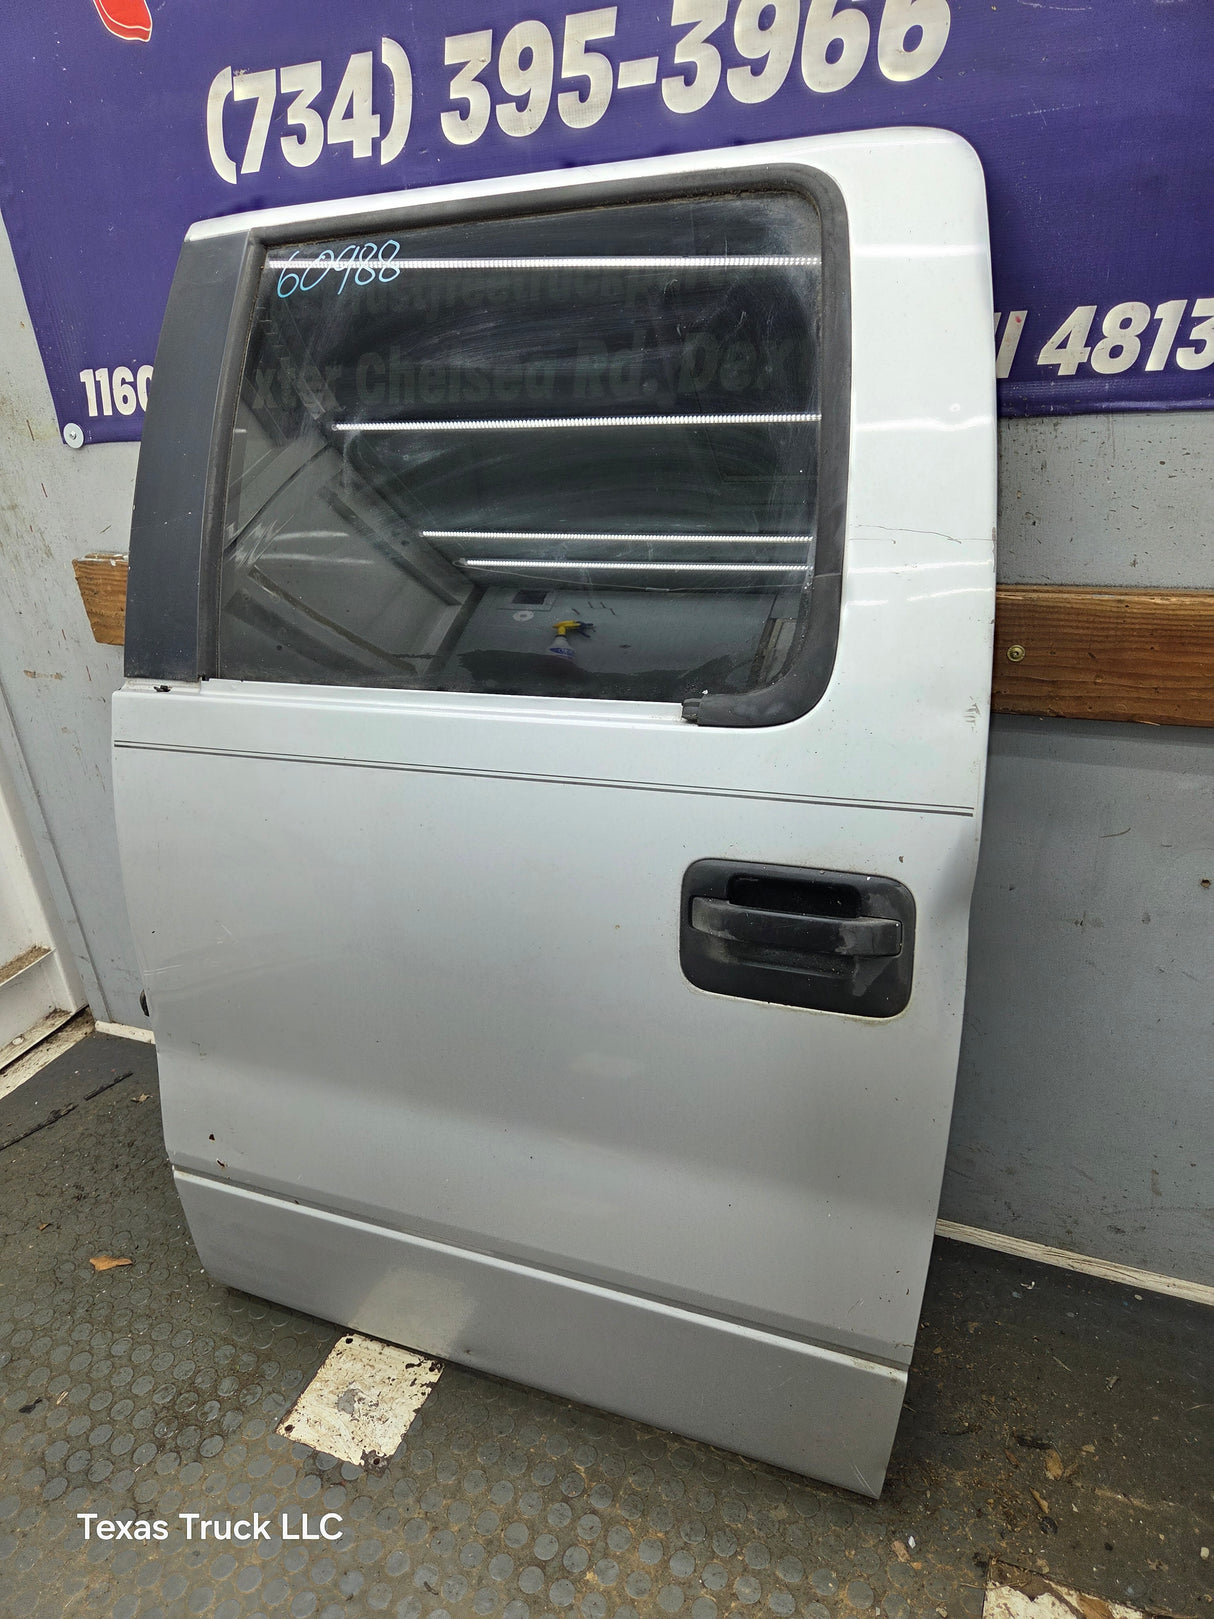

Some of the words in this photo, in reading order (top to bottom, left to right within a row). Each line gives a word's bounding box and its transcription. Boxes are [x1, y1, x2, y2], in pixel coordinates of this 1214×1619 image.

[206, 37, 412, 185] (734)
[439, 0, 951, 146] 395-3966
[277, 239, 400, 298] 60988
